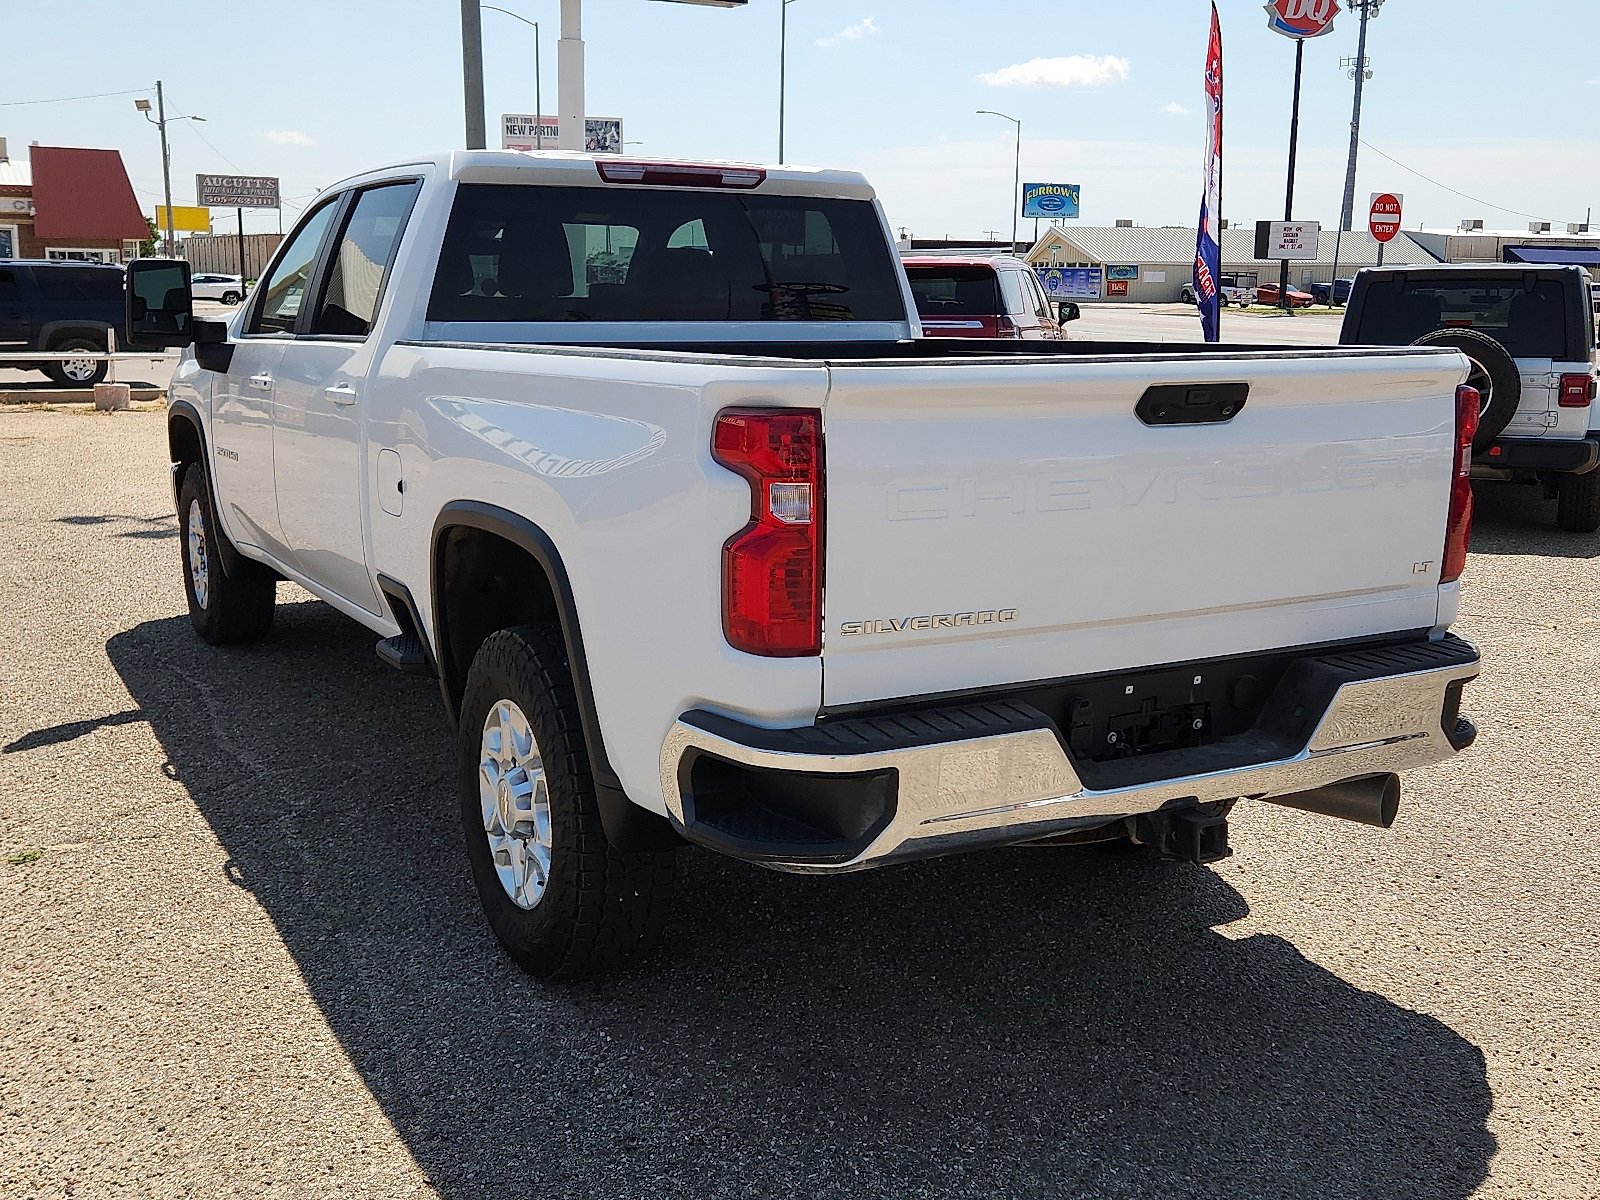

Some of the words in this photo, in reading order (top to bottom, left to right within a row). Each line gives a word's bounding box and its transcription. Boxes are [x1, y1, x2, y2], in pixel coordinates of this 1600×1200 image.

[1284, 0, 1329, 25] DQ
[506, 125, 526, 135] NEW
[203, 177, 276, 189] AUCUTT'S
[1026, 185, 1078, 206] FURROW'S
[1375, 203, 1384, 211] DO
[1386, 203, 1397, 212] NOT
[1375, 225, 1394, 233] ENTER
[1412, 560, 1434, 575] LT
[840, 608, 1019, 636] SILVERADO
